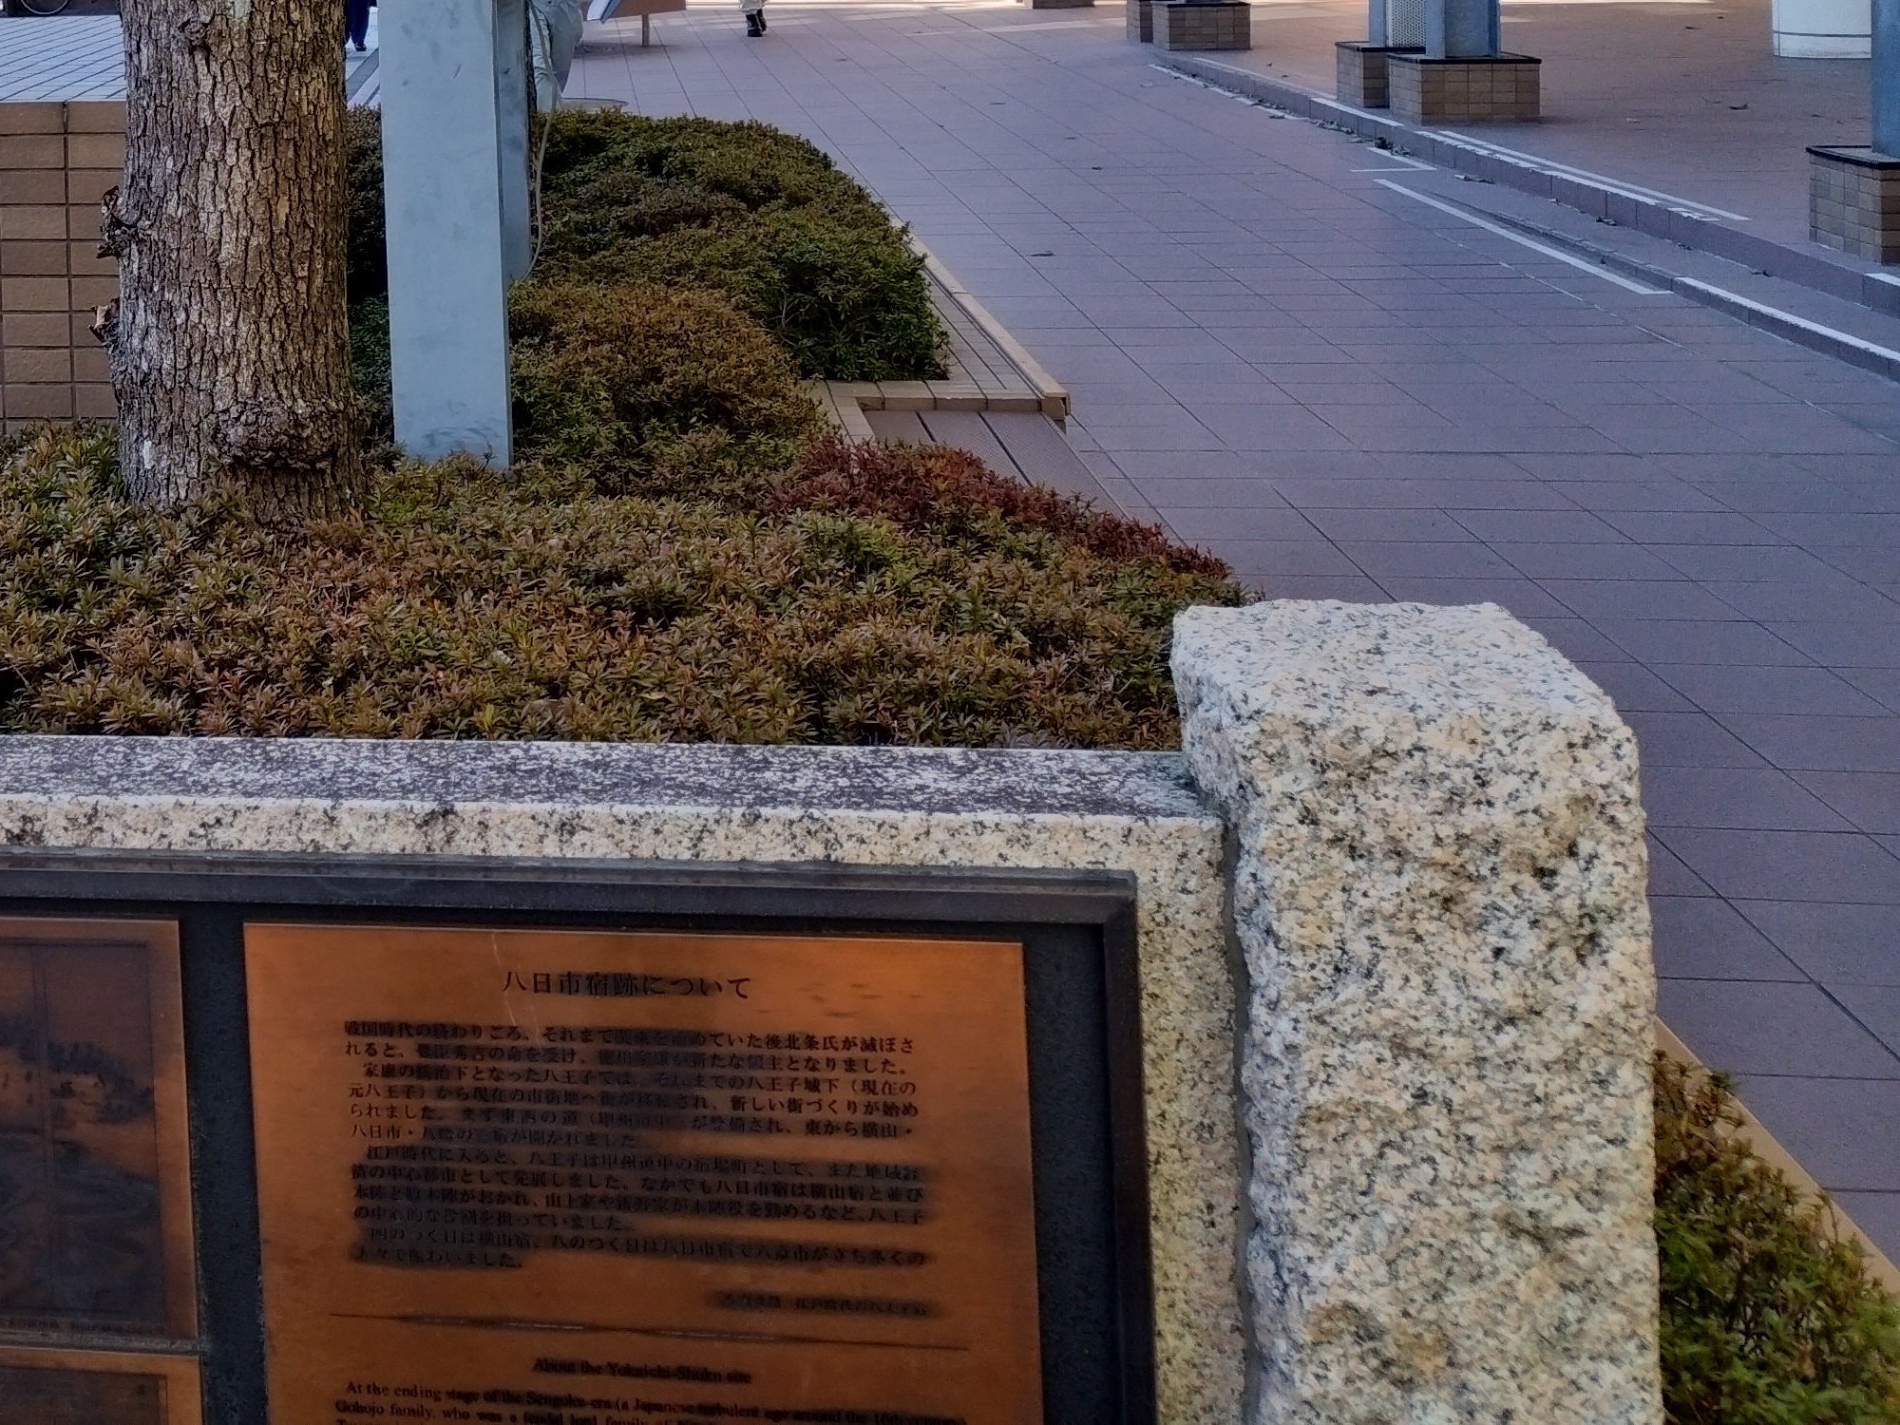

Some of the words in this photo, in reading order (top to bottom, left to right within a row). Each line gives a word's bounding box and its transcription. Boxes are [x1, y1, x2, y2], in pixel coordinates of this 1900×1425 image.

[503, 971, 750, 999] 八日市宿跡について
[532, 1358, 575, 1373] About
[580, 1360, 602, 1375] the
[346, 1381, 362, 1394] At
[367, 1382, 388, 1396] the
[394, 1384, 441, 1402] ending
[483, 1390, 500, 1403] of
[502, 1390, 521, 1404] the
[442, 1406, 471, 1420] who
